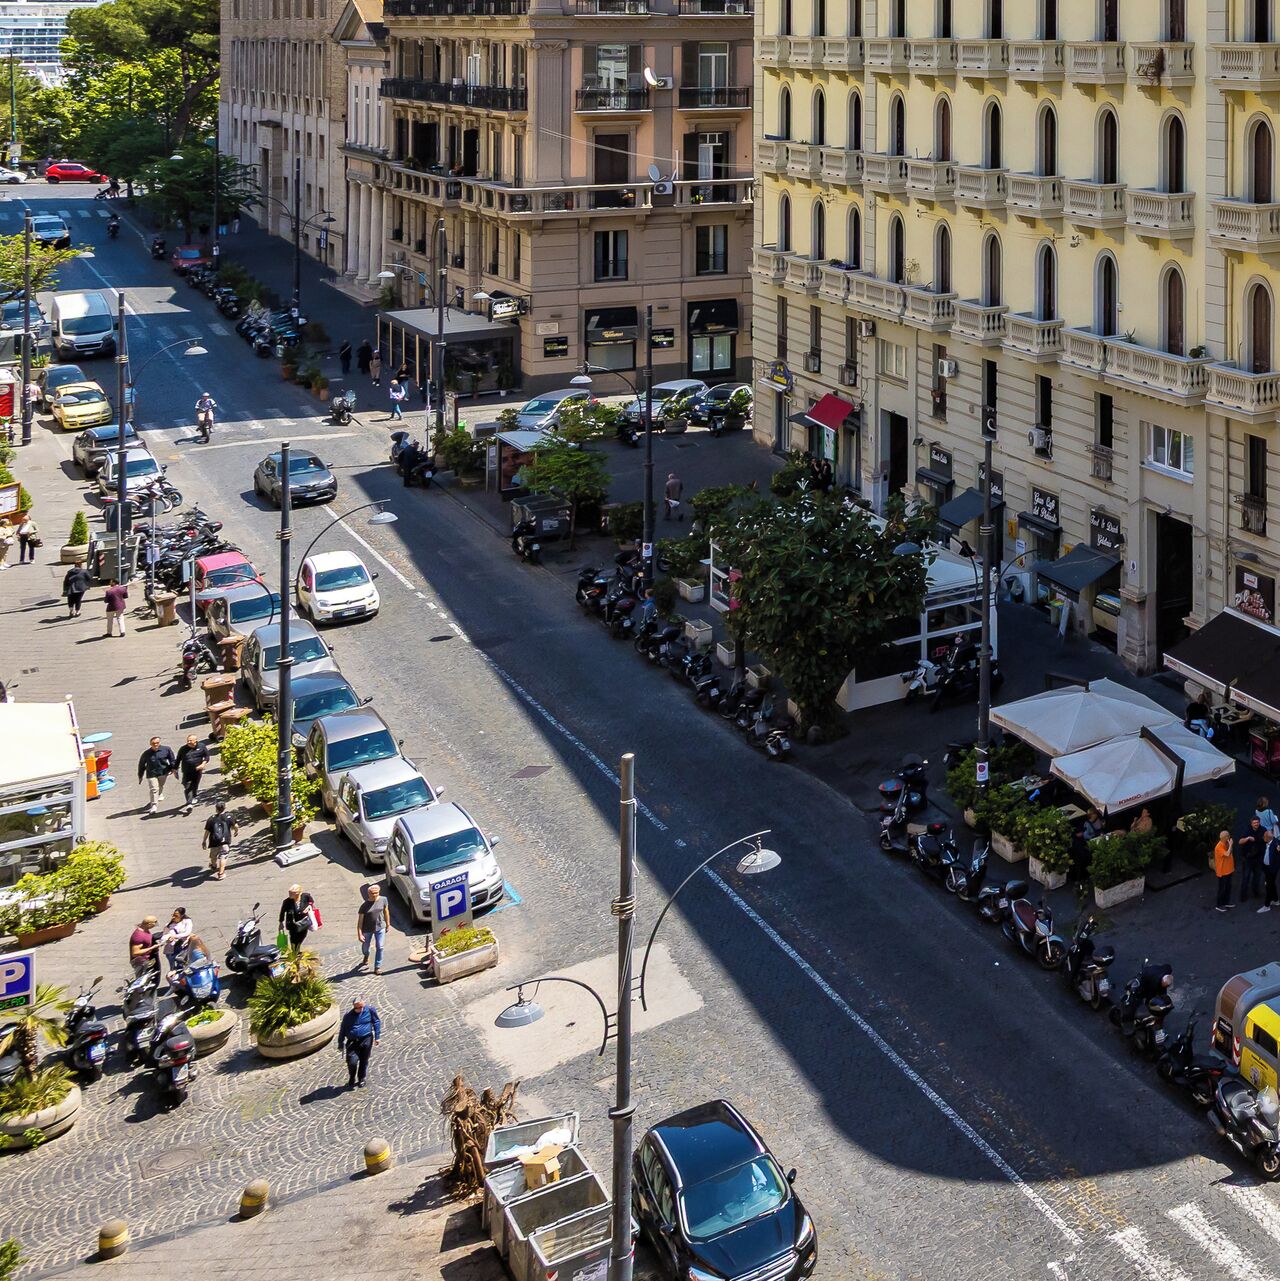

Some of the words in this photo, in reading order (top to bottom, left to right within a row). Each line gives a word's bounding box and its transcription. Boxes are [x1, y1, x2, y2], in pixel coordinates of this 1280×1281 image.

[1118, 794, 1141, 805] KIMBO
[434, 874, 467, 890] GARAGE
[440, 889, 463, 918] P
[0, 961, 26, 995] P
